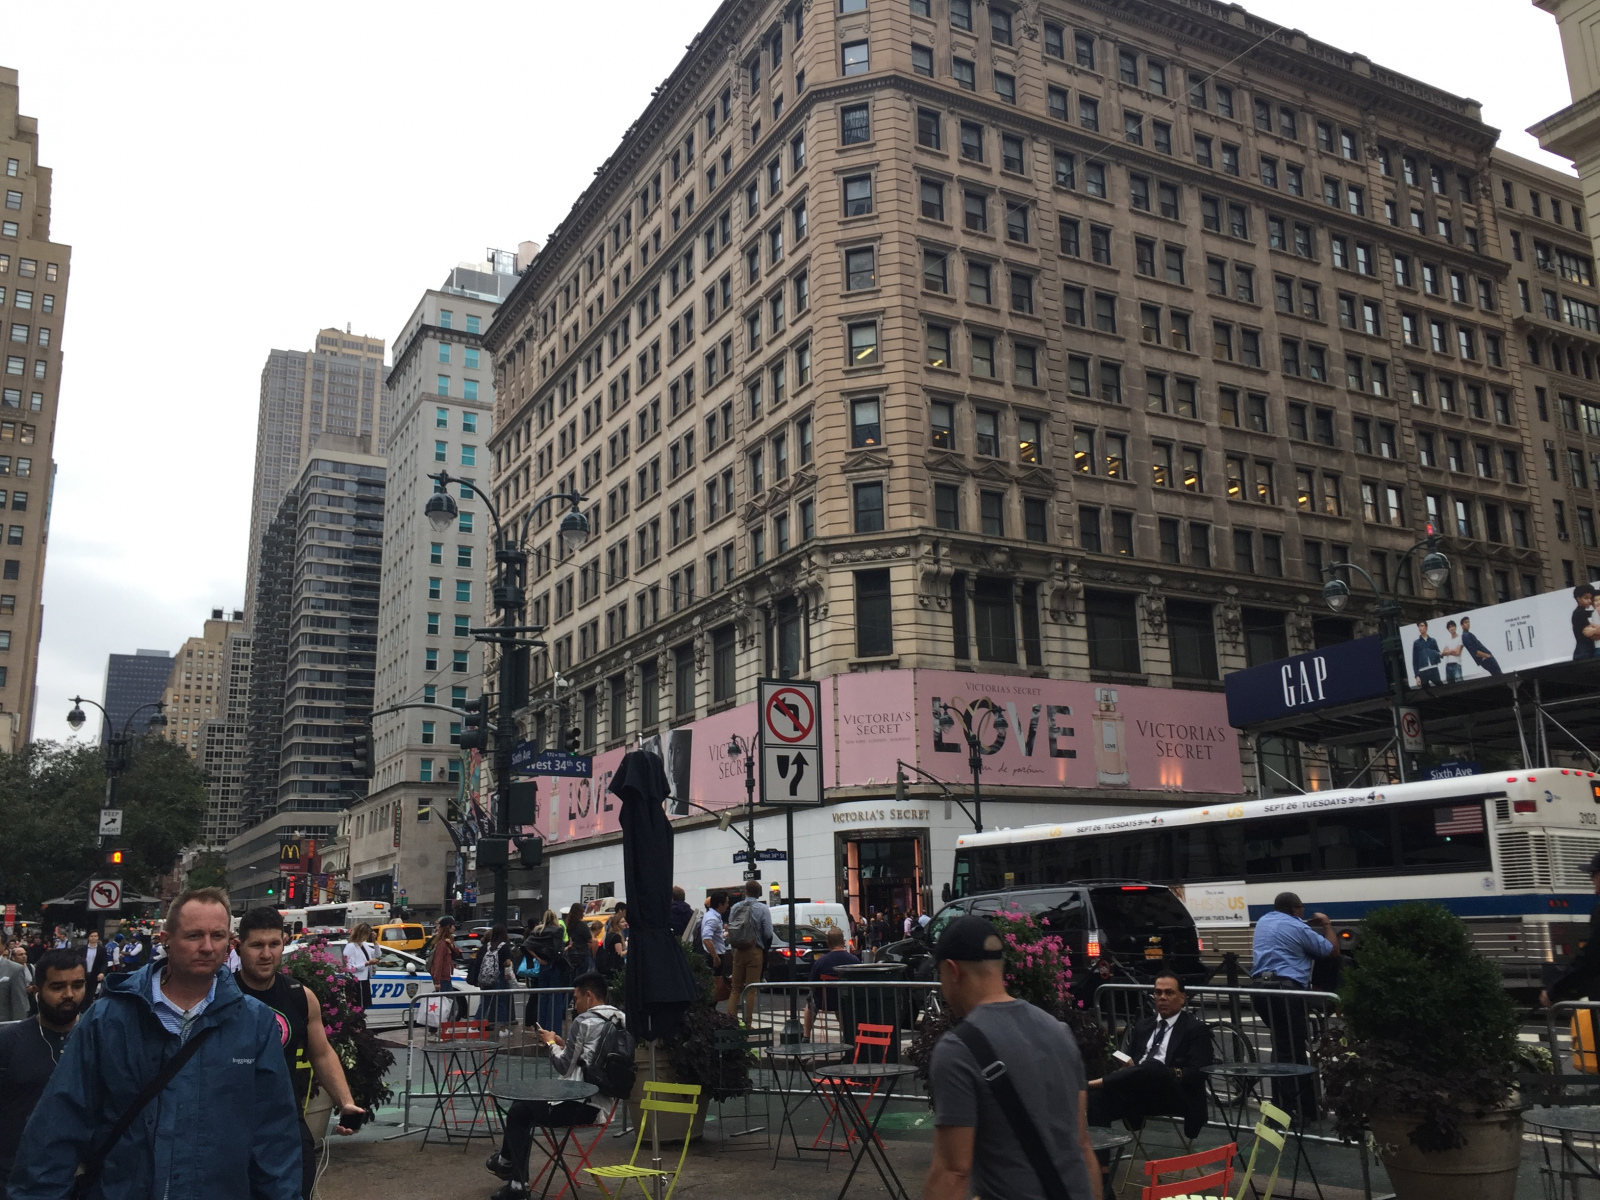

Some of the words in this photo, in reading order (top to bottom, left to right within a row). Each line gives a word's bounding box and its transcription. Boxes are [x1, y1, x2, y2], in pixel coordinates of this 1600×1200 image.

[1505, 625, 1535, 652] GAP
[965, 682, 1011, 693] VICTORIA'S
[1013, 686, 1042, 696] SECRET
[1281, 656, 1327, 707] GAP
[843, 711, 912, 725] VICTORIA'S
[856, 724, 901, 736] SECRET
[932, 696, 1077, 759] LOVE
[1136, 720, 1226, 742] VICTORIA'S
[523, 750, 531, 761] Ave
[1156, 740, 1213, 760] SECRET
[554, 760, 573, 771] 34th
[576, 760, 587, 772] St
[718, 758, 749, 780] SECRE
[1430, 768, 1453, 779] Sixth
[1455, 767, 1473, 777] Ave
[568, 770, 614, 820] LOVE
[832, 809, 885, 823] VICTORIA'S
[889, 809, 930, 820] SECRET
[1227, 805, 1244, 819] US
[1264, 803, 1285, 813] SEPT
[1286, 802, 1298, 810] 26
[1302, 797, 1348, 809] TUESDAYS
[1050, 826, 1062, 838] US
[1104, 820, 1137, 830] TUESDAYS
[583, 896, 595, 904] 25
[1227, 896, 1245, 910] US
[371, 982, 405, 998] YPD
